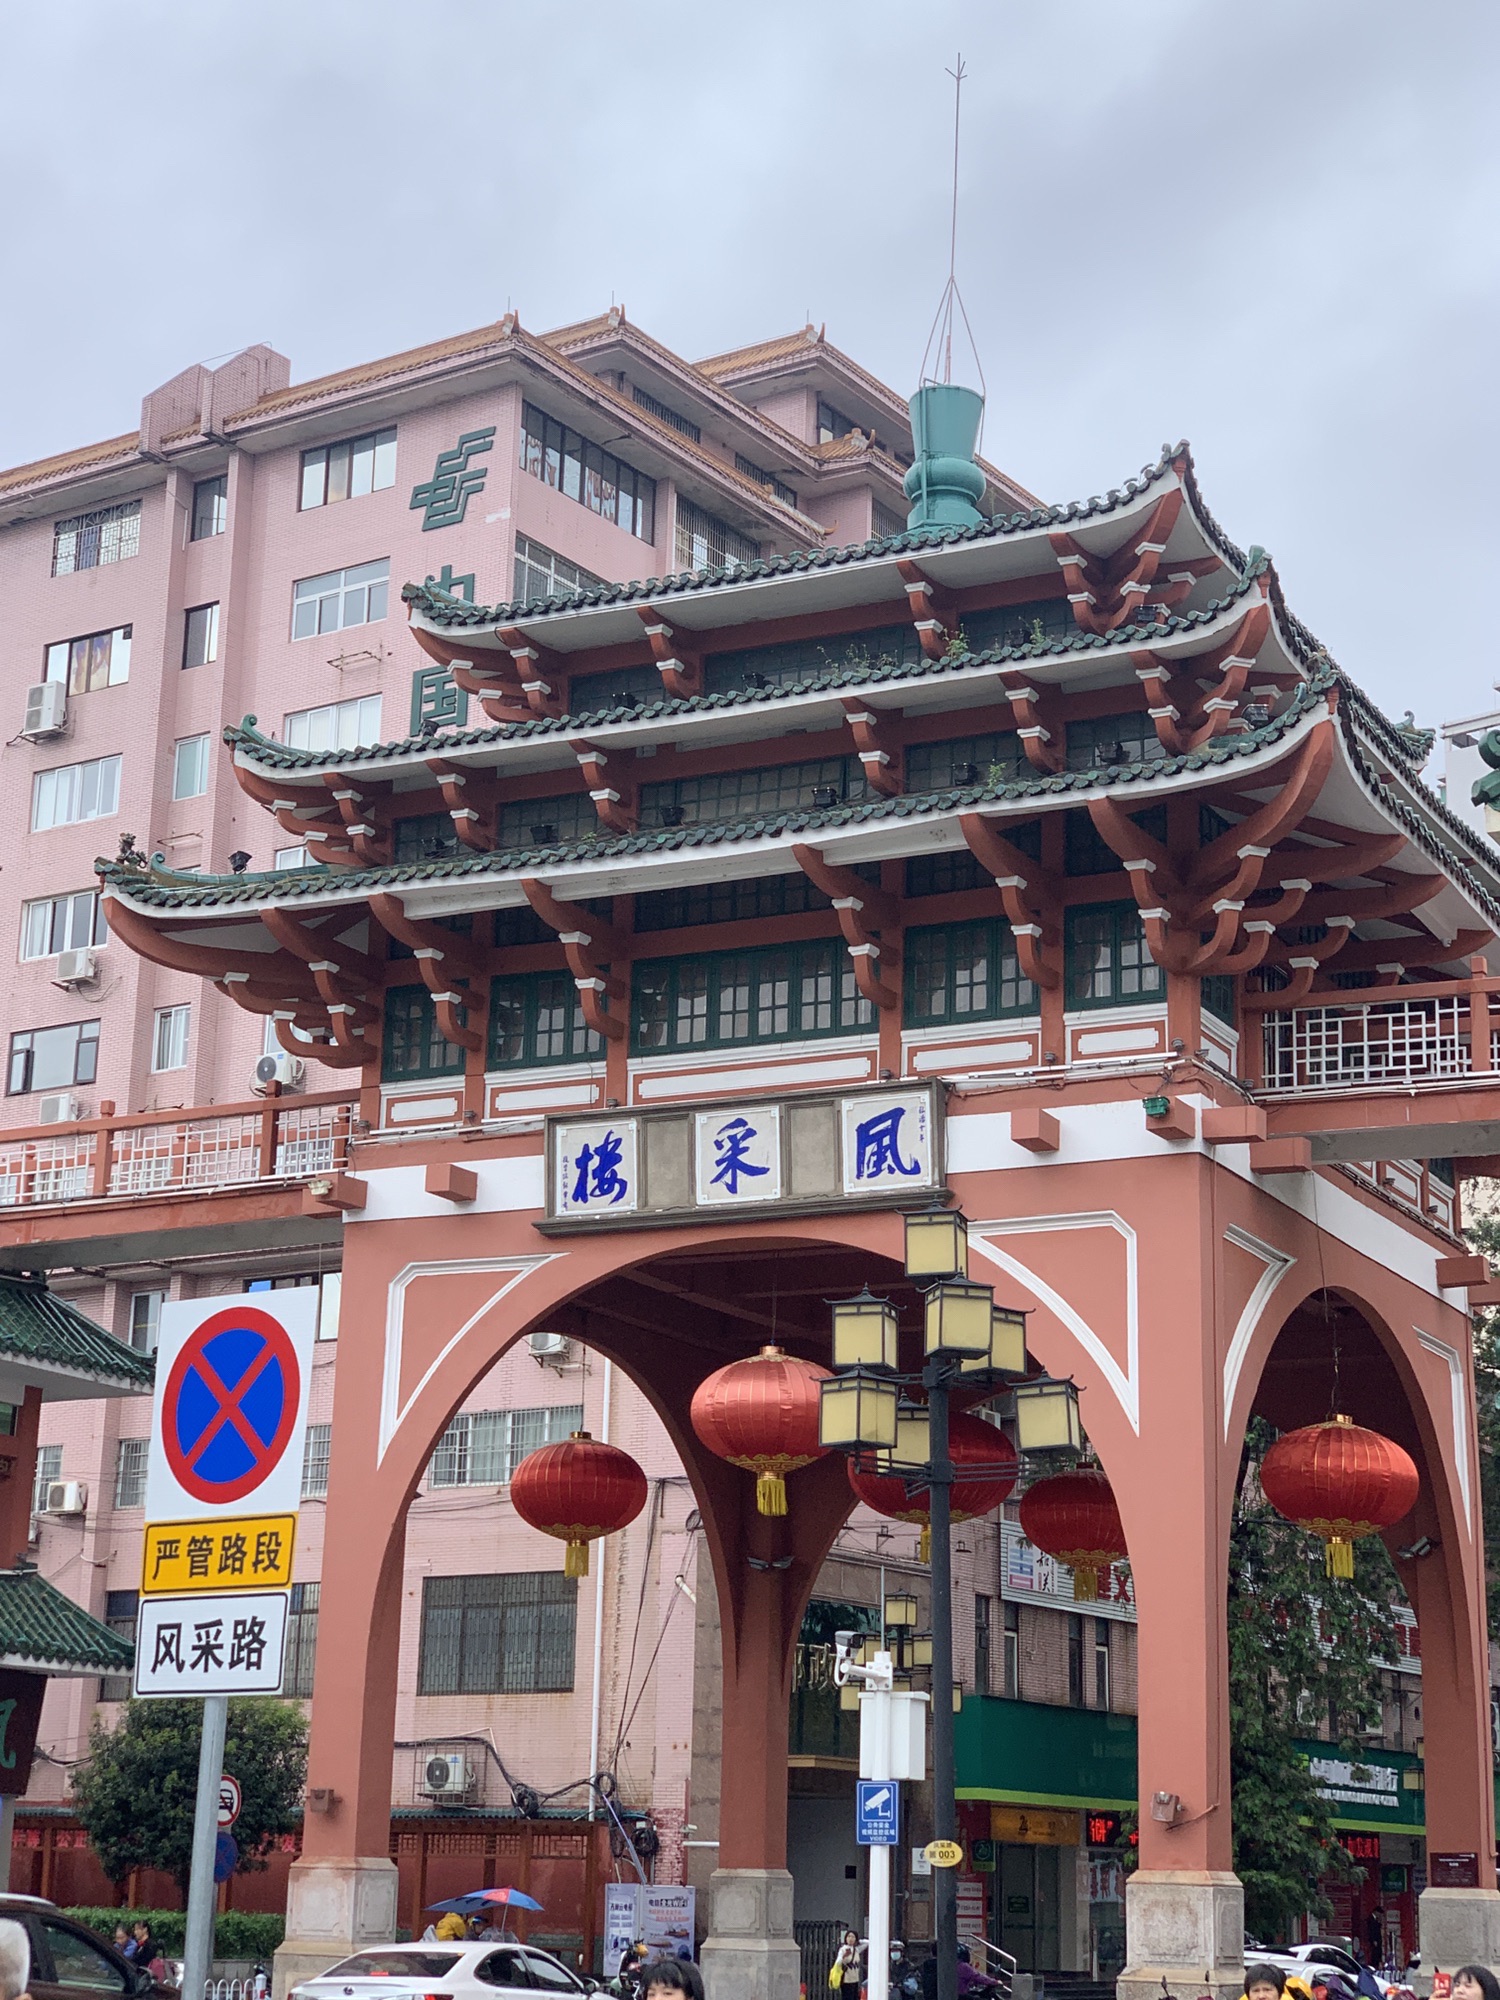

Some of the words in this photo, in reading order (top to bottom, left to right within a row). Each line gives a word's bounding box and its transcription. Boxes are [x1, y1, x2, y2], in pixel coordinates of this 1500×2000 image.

[152, 1530, 283, 1580] 严管路段
[151, 1616, 268, 1673] 风采路
[938, 1850, 956, 1859] 003
